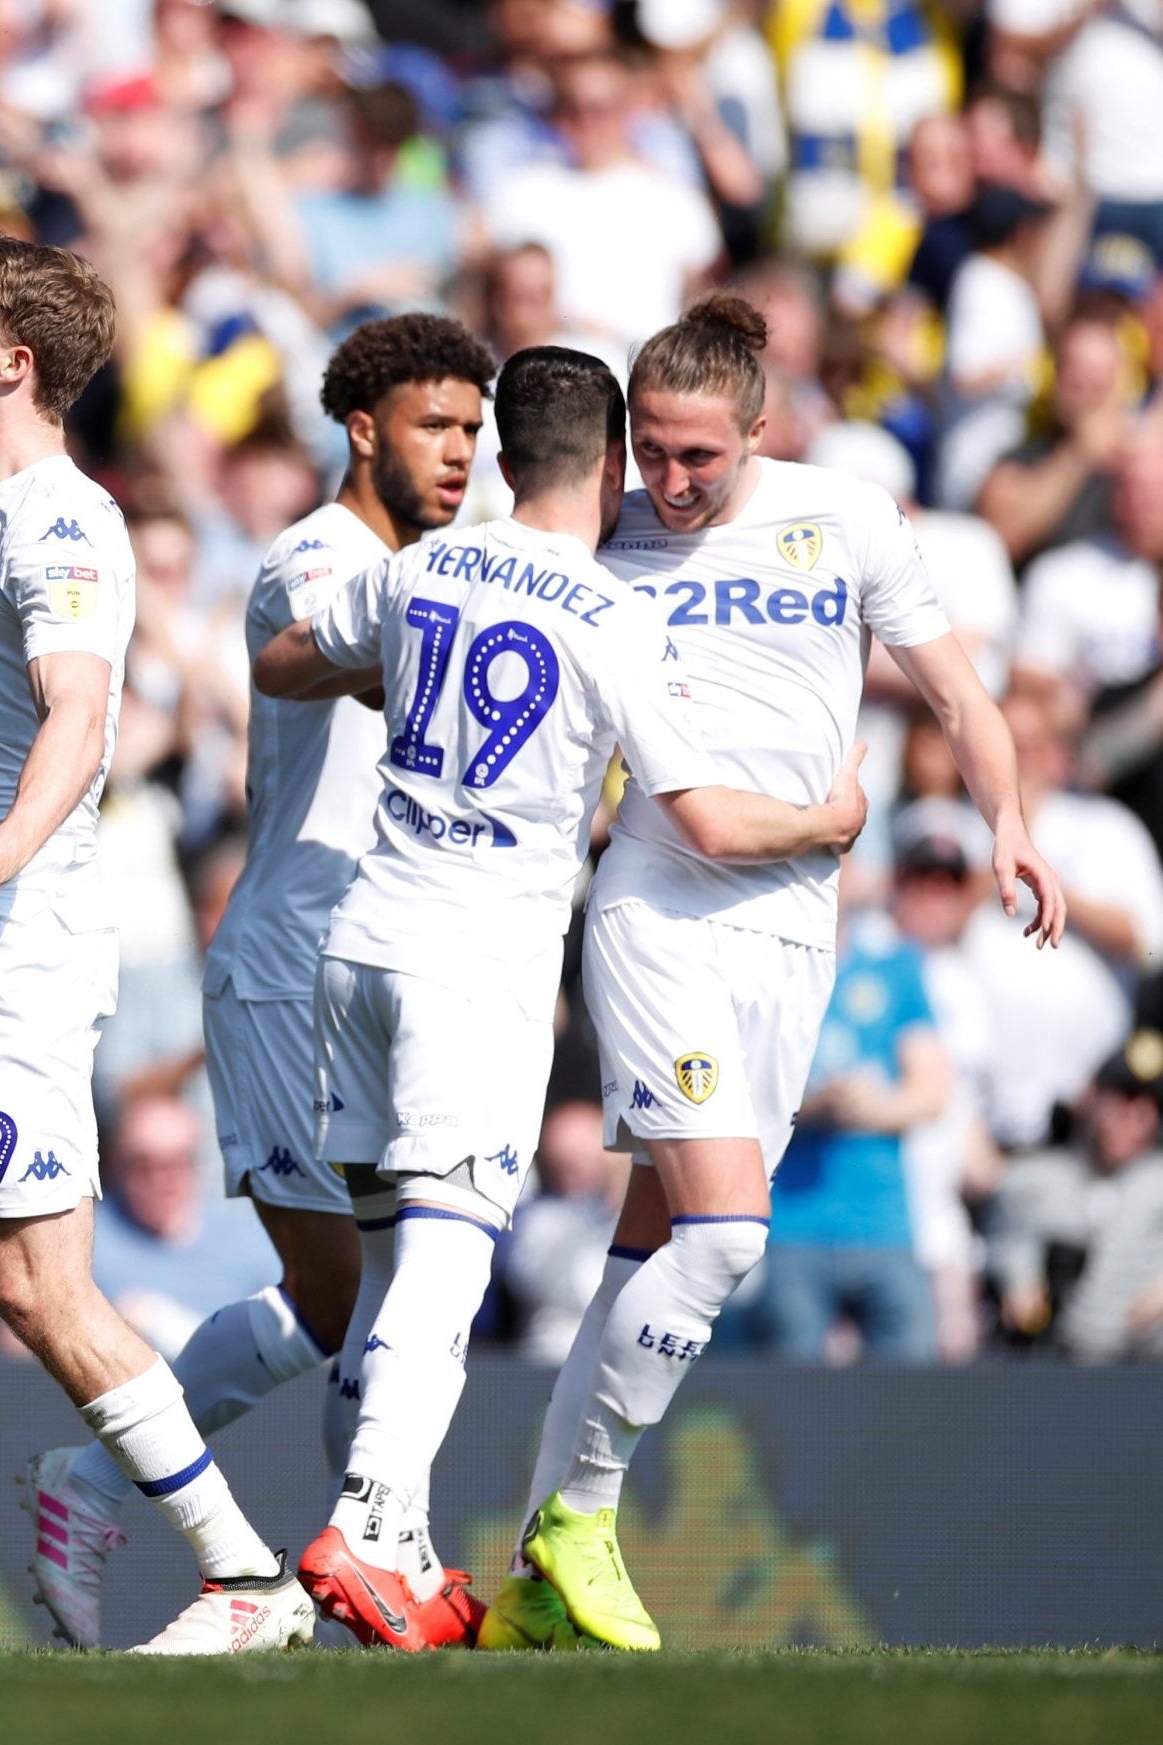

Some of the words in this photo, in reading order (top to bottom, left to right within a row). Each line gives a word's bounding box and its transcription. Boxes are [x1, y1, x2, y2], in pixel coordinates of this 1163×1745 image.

[48, 567, 71, 580] sky
[73, 567, 97, 582] bet
[426, 543, 616, 628] HERNANDEZ
[390, 597, 560, 789] 19
[231, 1605, 272, 1653] adidas
